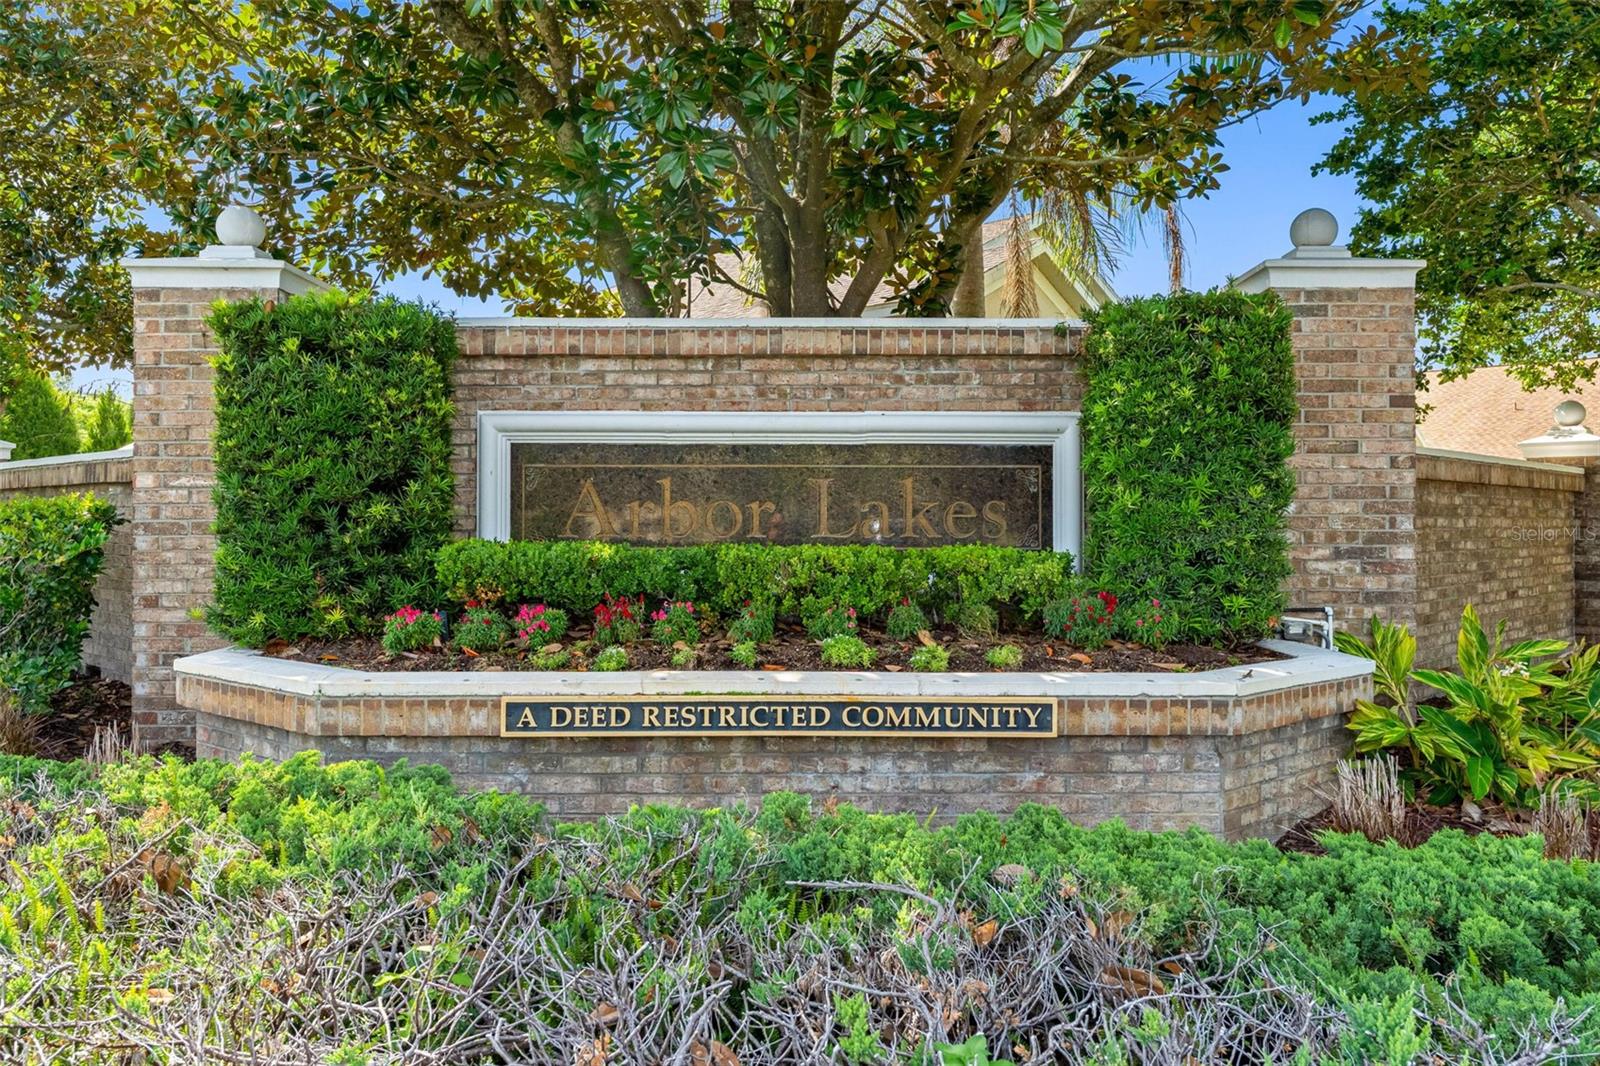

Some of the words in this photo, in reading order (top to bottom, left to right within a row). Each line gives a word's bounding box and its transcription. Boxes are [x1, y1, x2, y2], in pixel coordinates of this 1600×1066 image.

[557, 476, 776, 541] Arbor
[807, 476, 1009, 538] Lakes
[516, 706, 538, 728] A
[550, 706, 631, 727] DEED
[642, 706, 831, 727] RESTRICTED
[841, 706, 1043, 728] COMMUNITY
